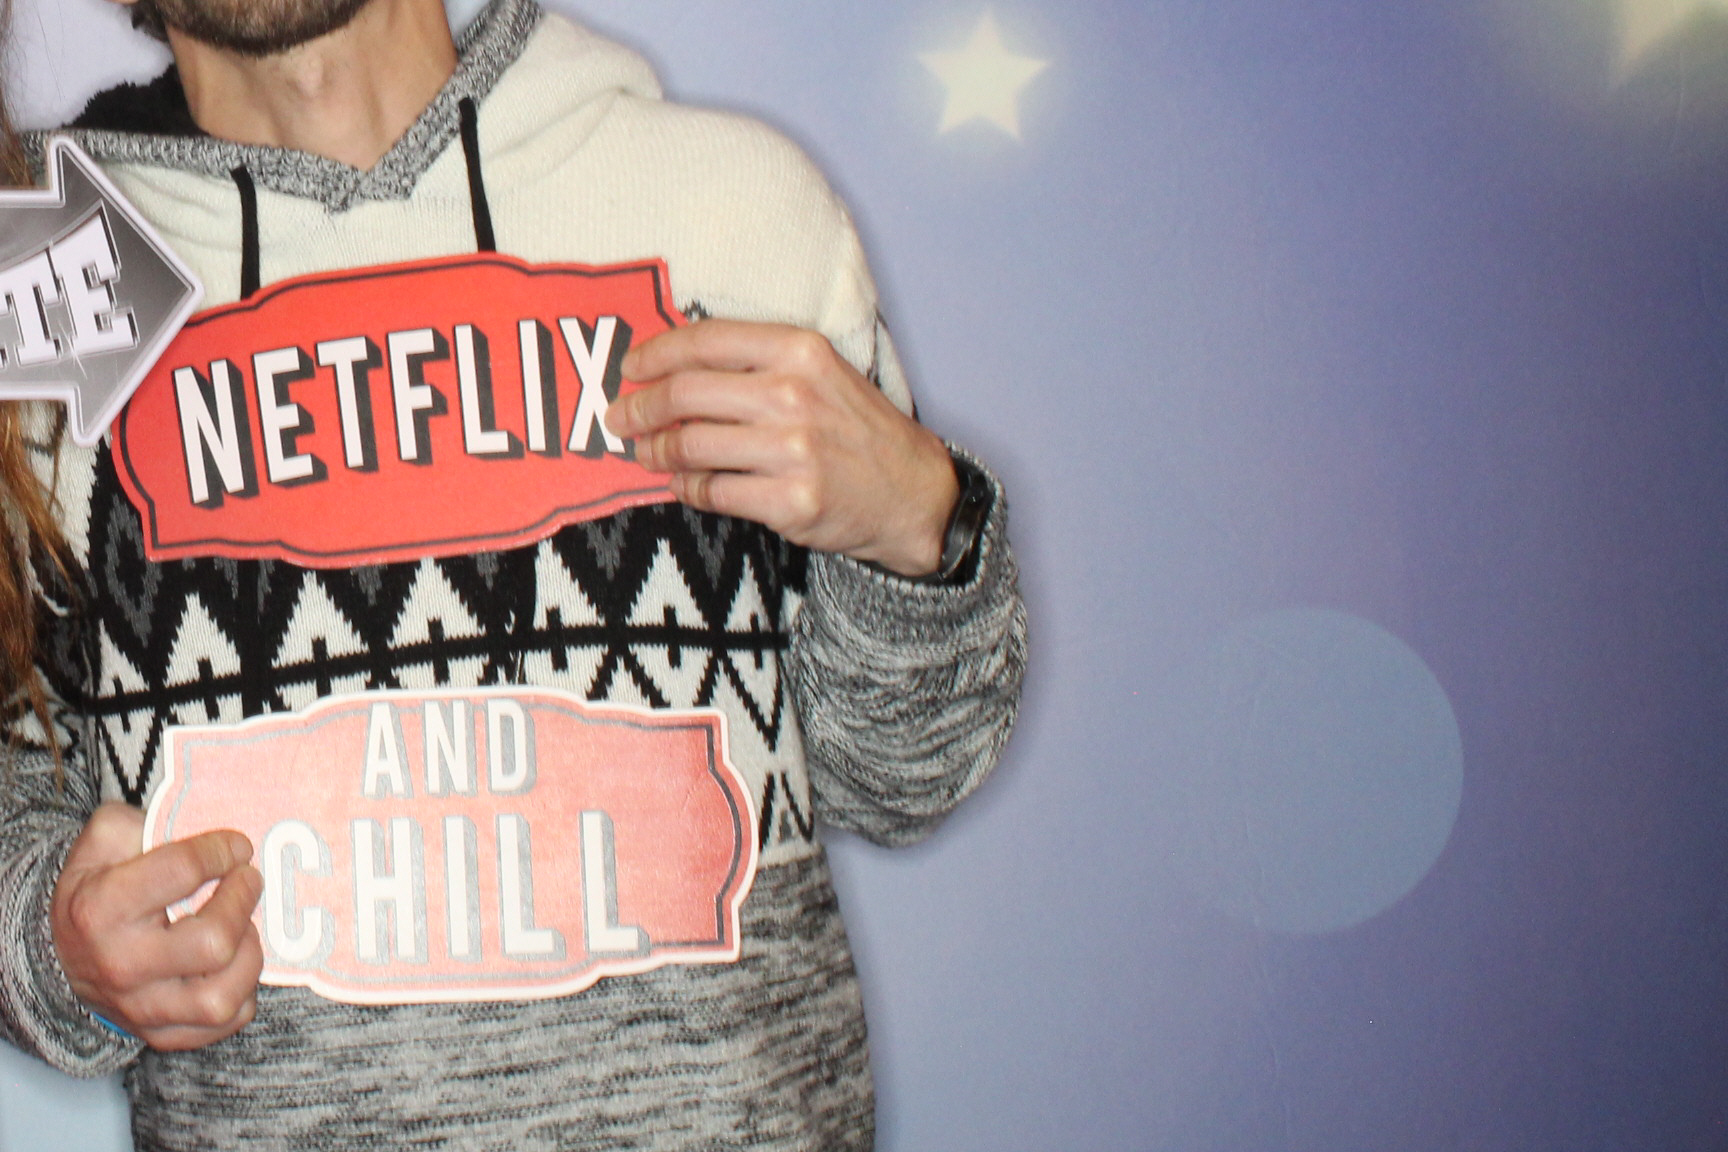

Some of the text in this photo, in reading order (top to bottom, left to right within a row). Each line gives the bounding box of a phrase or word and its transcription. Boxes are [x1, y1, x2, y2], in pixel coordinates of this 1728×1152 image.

[173, 315, 634, 508] NETFLIX
[362, 698, 537, 798] AND
[261, 810, 650, 965] CHILL
